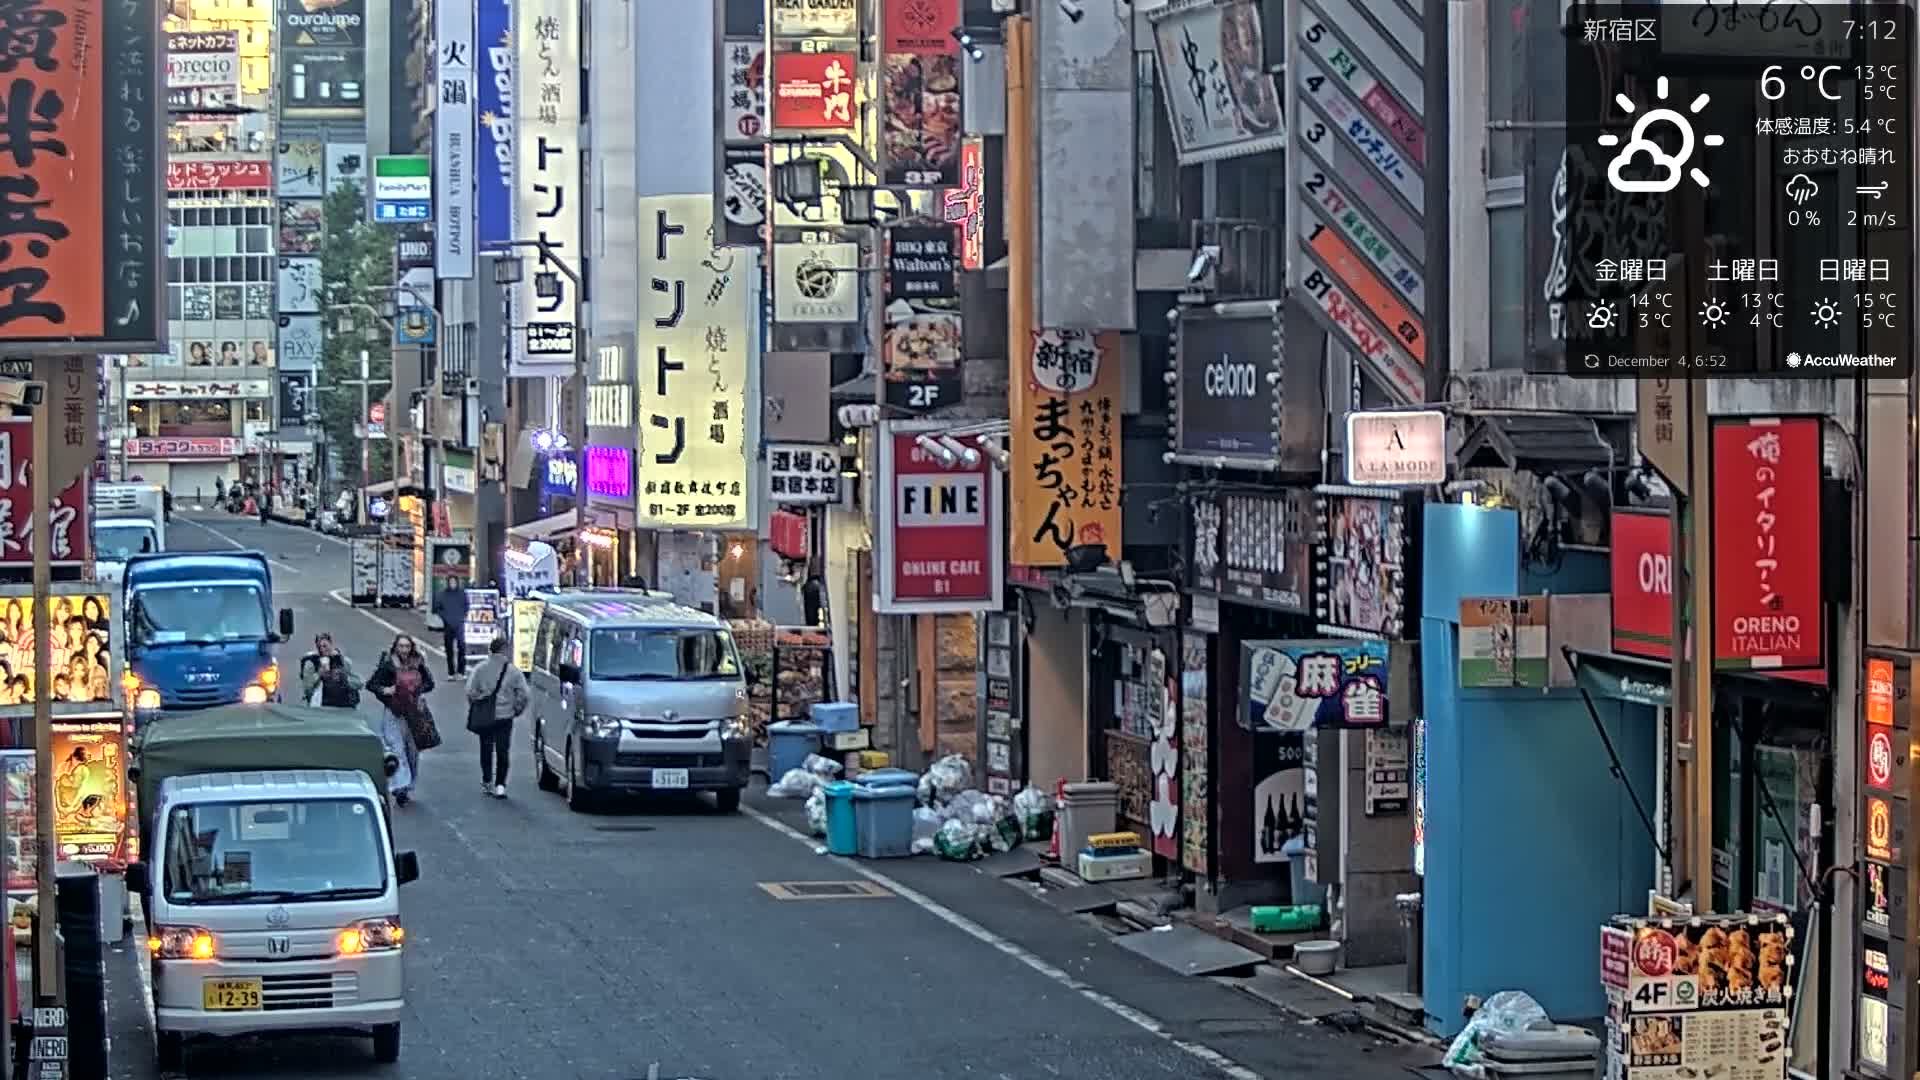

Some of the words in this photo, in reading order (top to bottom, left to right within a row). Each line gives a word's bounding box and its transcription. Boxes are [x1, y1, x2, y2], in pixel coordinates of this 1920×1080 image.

[1306, 23, 1326, 43] 5
[442, 40, 468, 104] 火鍋
[1306, 76, 1325, 92] 4
[1307, 122, 1326, 143] 3
[1349, 119, 1404, 179] センチュリー
[1305, 173, 1325, 195] 2
[1309, 222, 1326, 241] 1
[892, 256, 950, 272] Walton's
[1304, 269, 1332, 299] B1
[651, 210, 685, 464] トントン
[1036, 341, 1096, 374] 新宿
[1205, 353, 1256, 397] celona
[64, 355, 84, 446] 通り一番街
[908, 385, 938, 406] 2F
[771, 451, 835, 472] 酒場心
[1033, 397, 1080, 550] まっちゃん
[904, 486, 978, 514] FINE
[1747, 432, 1780, 604] 俺のイタリアン
[903, 562, 946, 577] ONLINE
[951, 561, 980, 576] CAFE
[1733, 616, 1800, 633] ORENO
[1732, 635, 1800, 652] ITALIAN
[218, 991, 259, 1007] 12-39
[1635, 982, 1668, 1004] 4F
[1701, 987, 1783, 1005] 炭火焼き鳥
[33, 1008, 65, 1027] NERO
[36, 1038, 66, 1057] NERO
